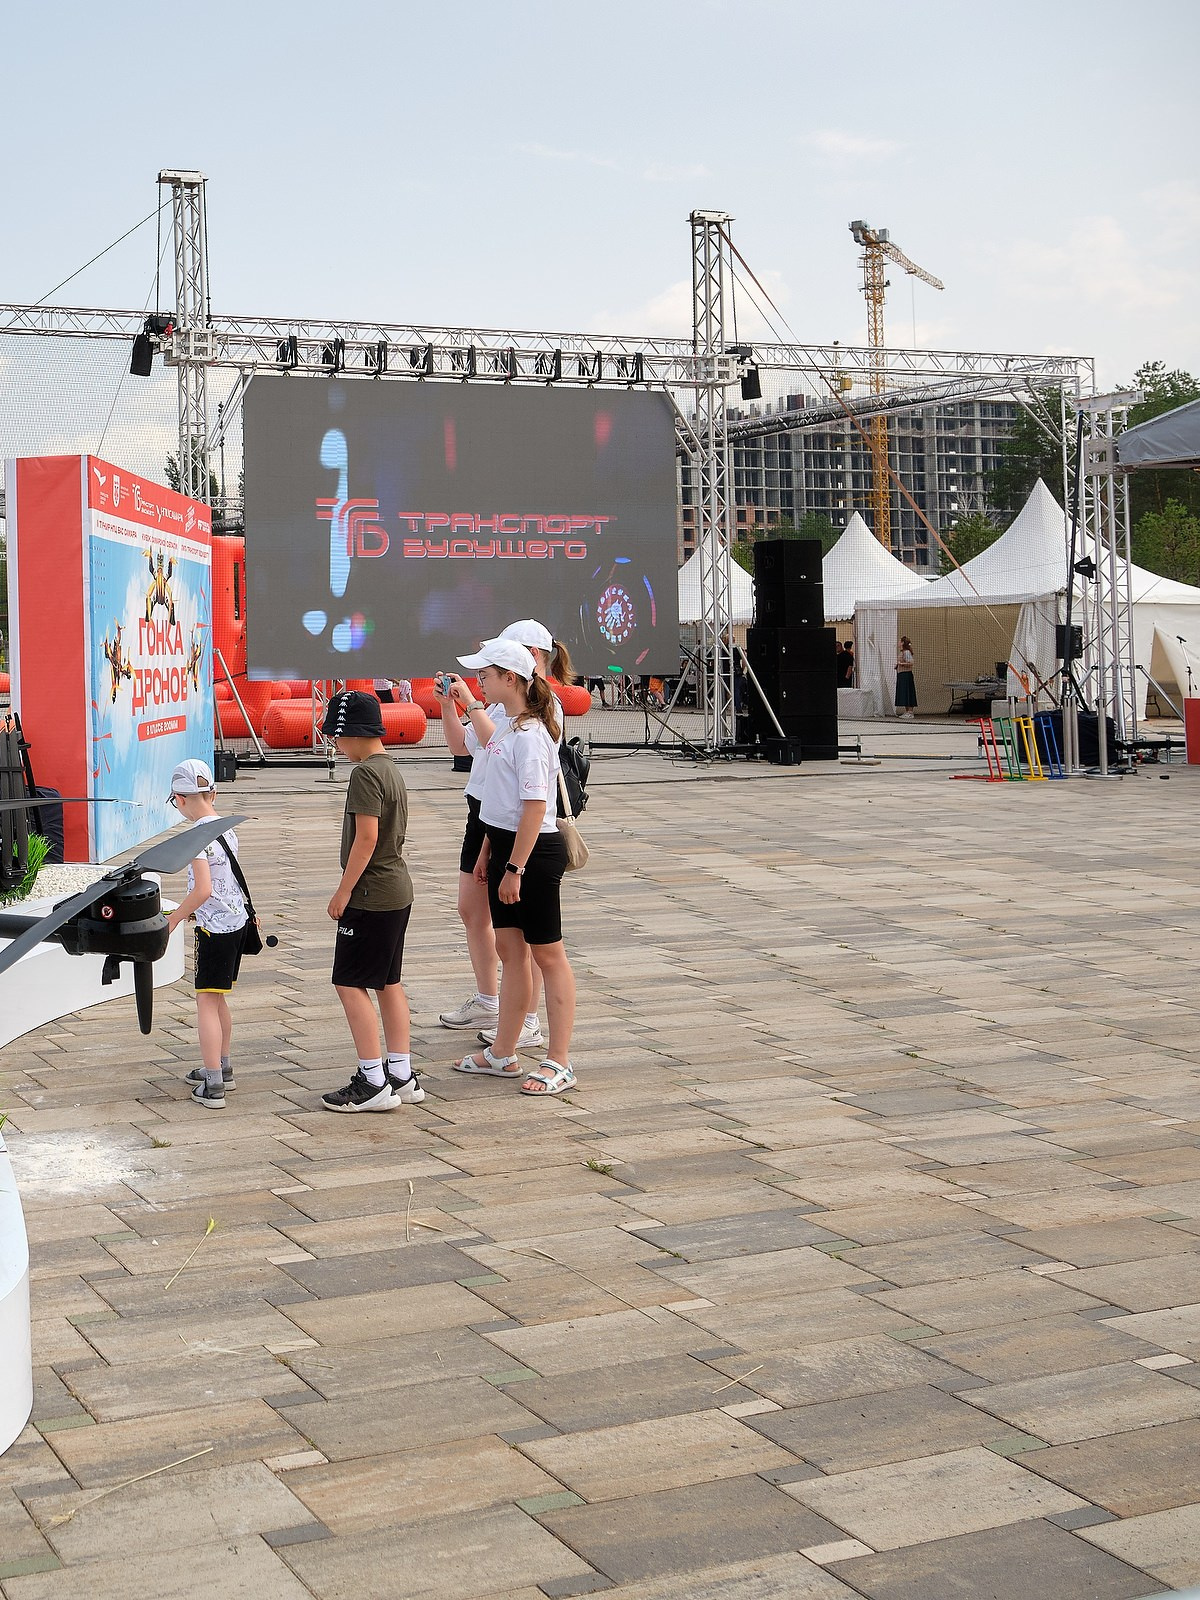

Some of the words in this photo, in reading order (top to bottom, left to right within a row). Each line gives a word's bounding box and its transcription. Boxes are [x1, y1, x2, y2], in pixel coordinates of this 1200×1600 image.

[399, 511, 610, 535] ТРАНСПОРТ
[138, 616, 184, 656] ГОНКА
[132, 666, 188, 717] ДРОНОВ
[338, 926, 354, 936] FILA
